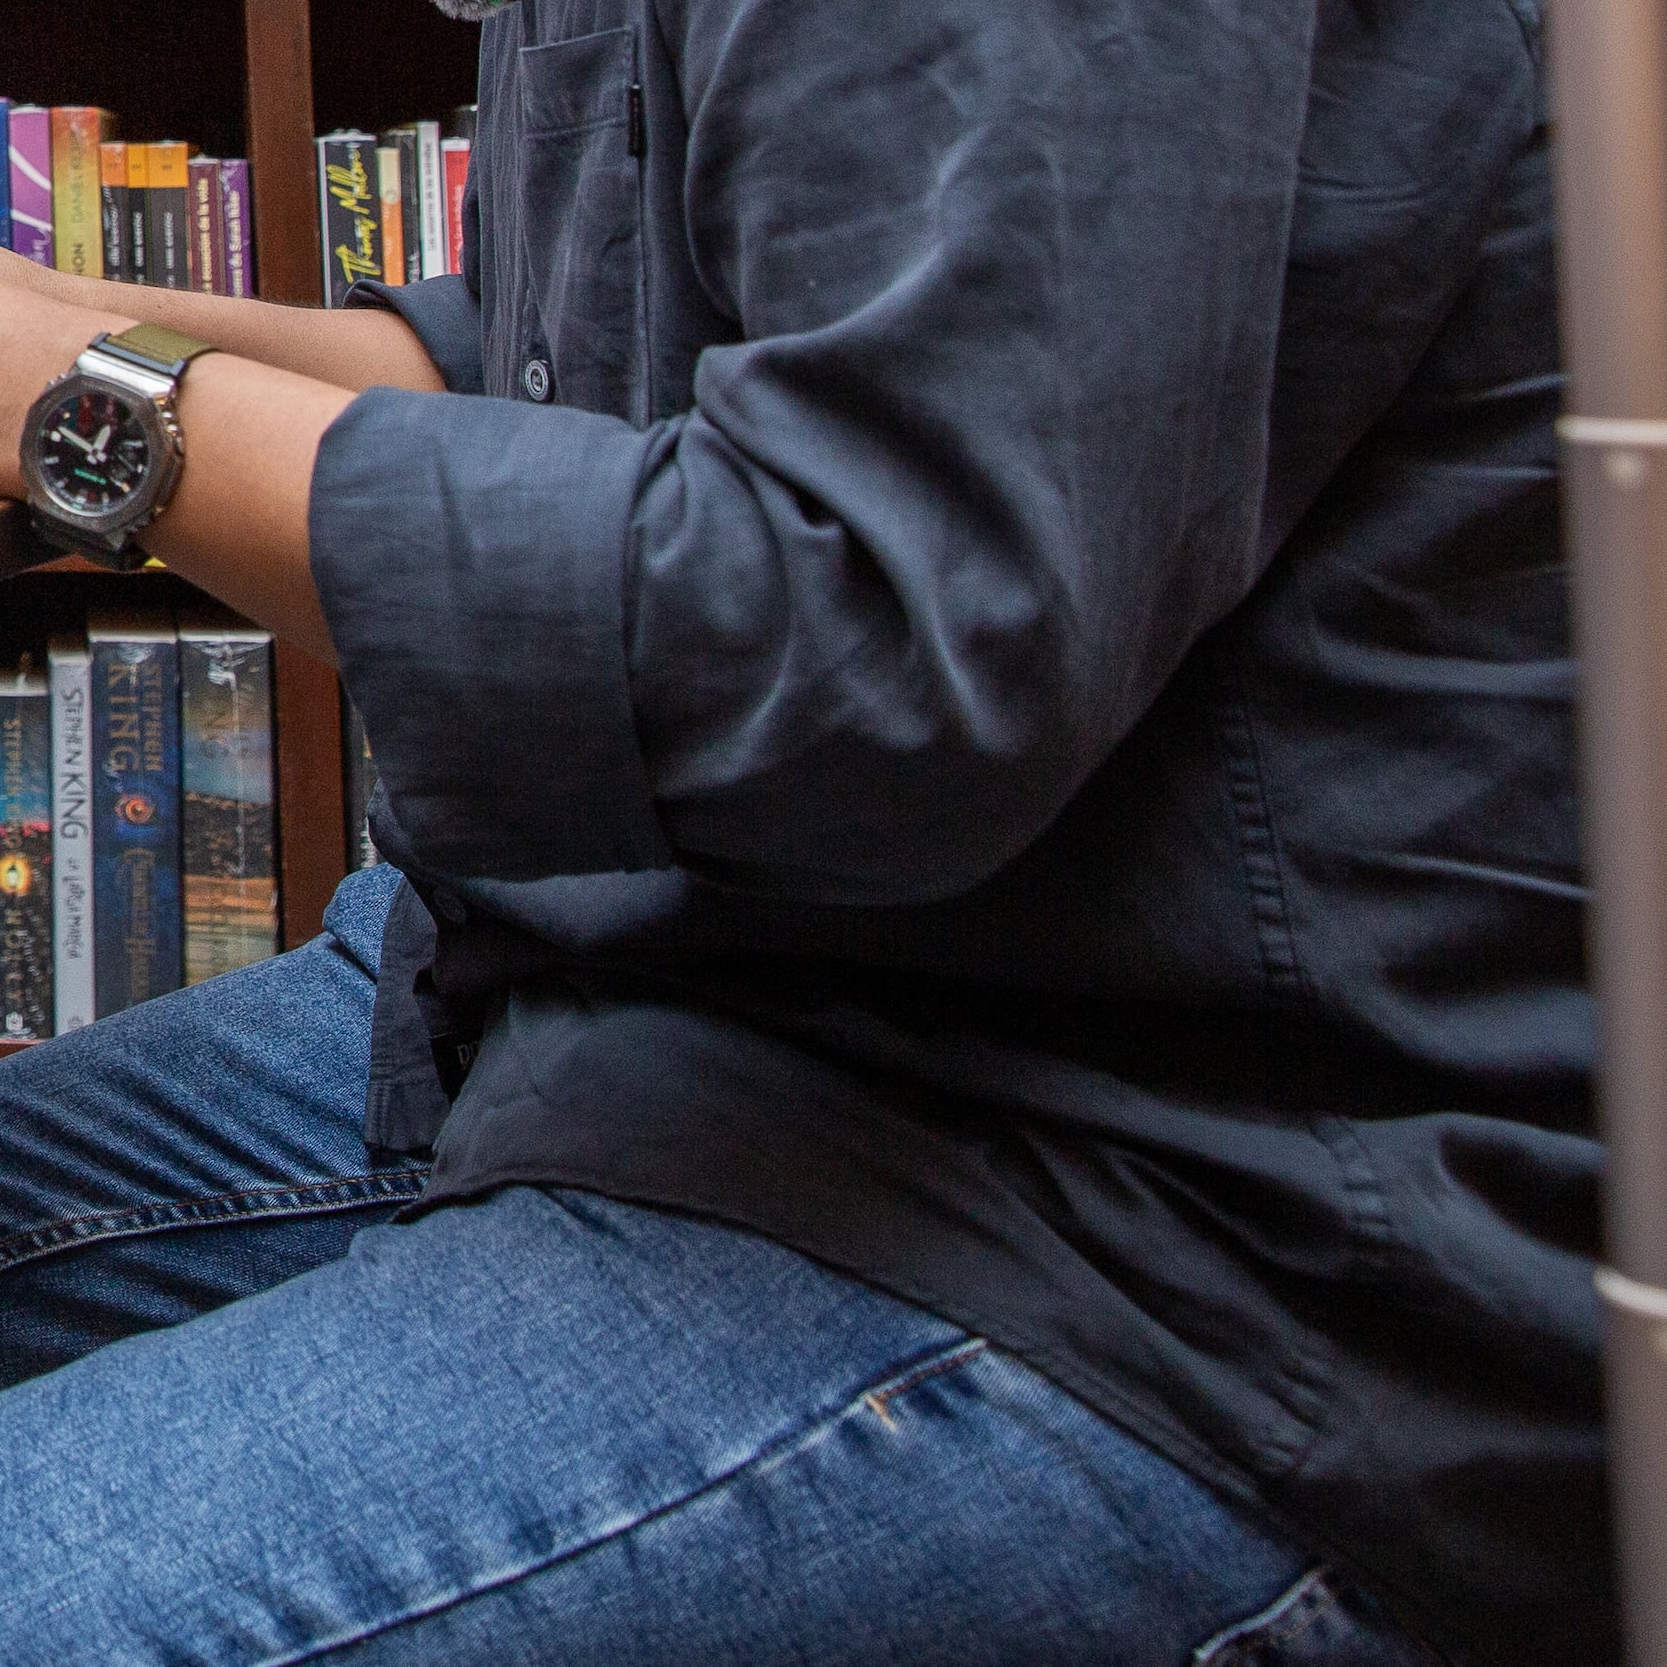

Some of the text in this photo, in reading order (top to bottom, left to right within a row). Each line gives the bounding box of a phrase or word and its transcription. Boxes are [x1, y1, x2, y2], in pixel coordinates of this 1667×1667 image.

[59, 687, 86, 840] STEPHEN KING
[107, 663, 140, 772] KING
[140, 662, 163, 771] STEPHEN
